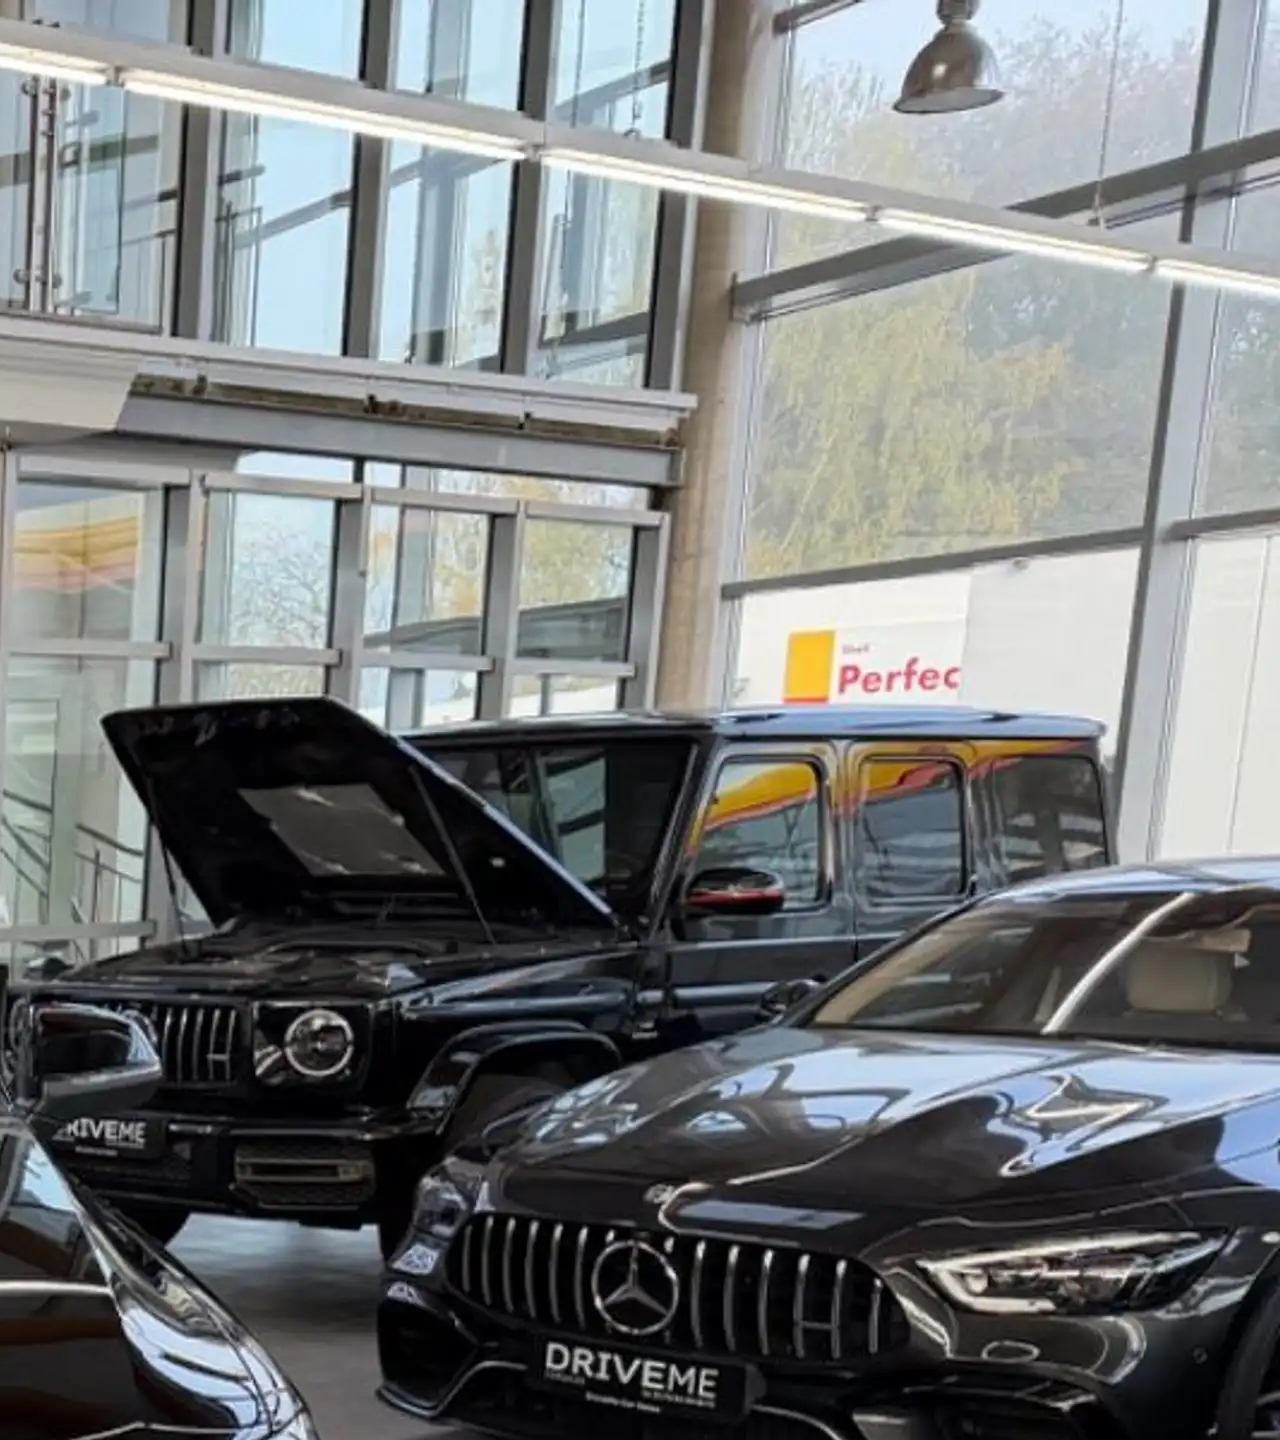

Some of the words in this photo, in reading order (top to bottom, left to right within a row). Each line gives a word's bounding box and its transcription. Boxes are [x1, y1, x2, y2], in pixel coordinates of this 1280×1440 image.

[838, 656, 960, 695] Perfec
[53, 1117, 146, 1144] RIVEME
[545, 1341, 719, 1399] DRIVEME
